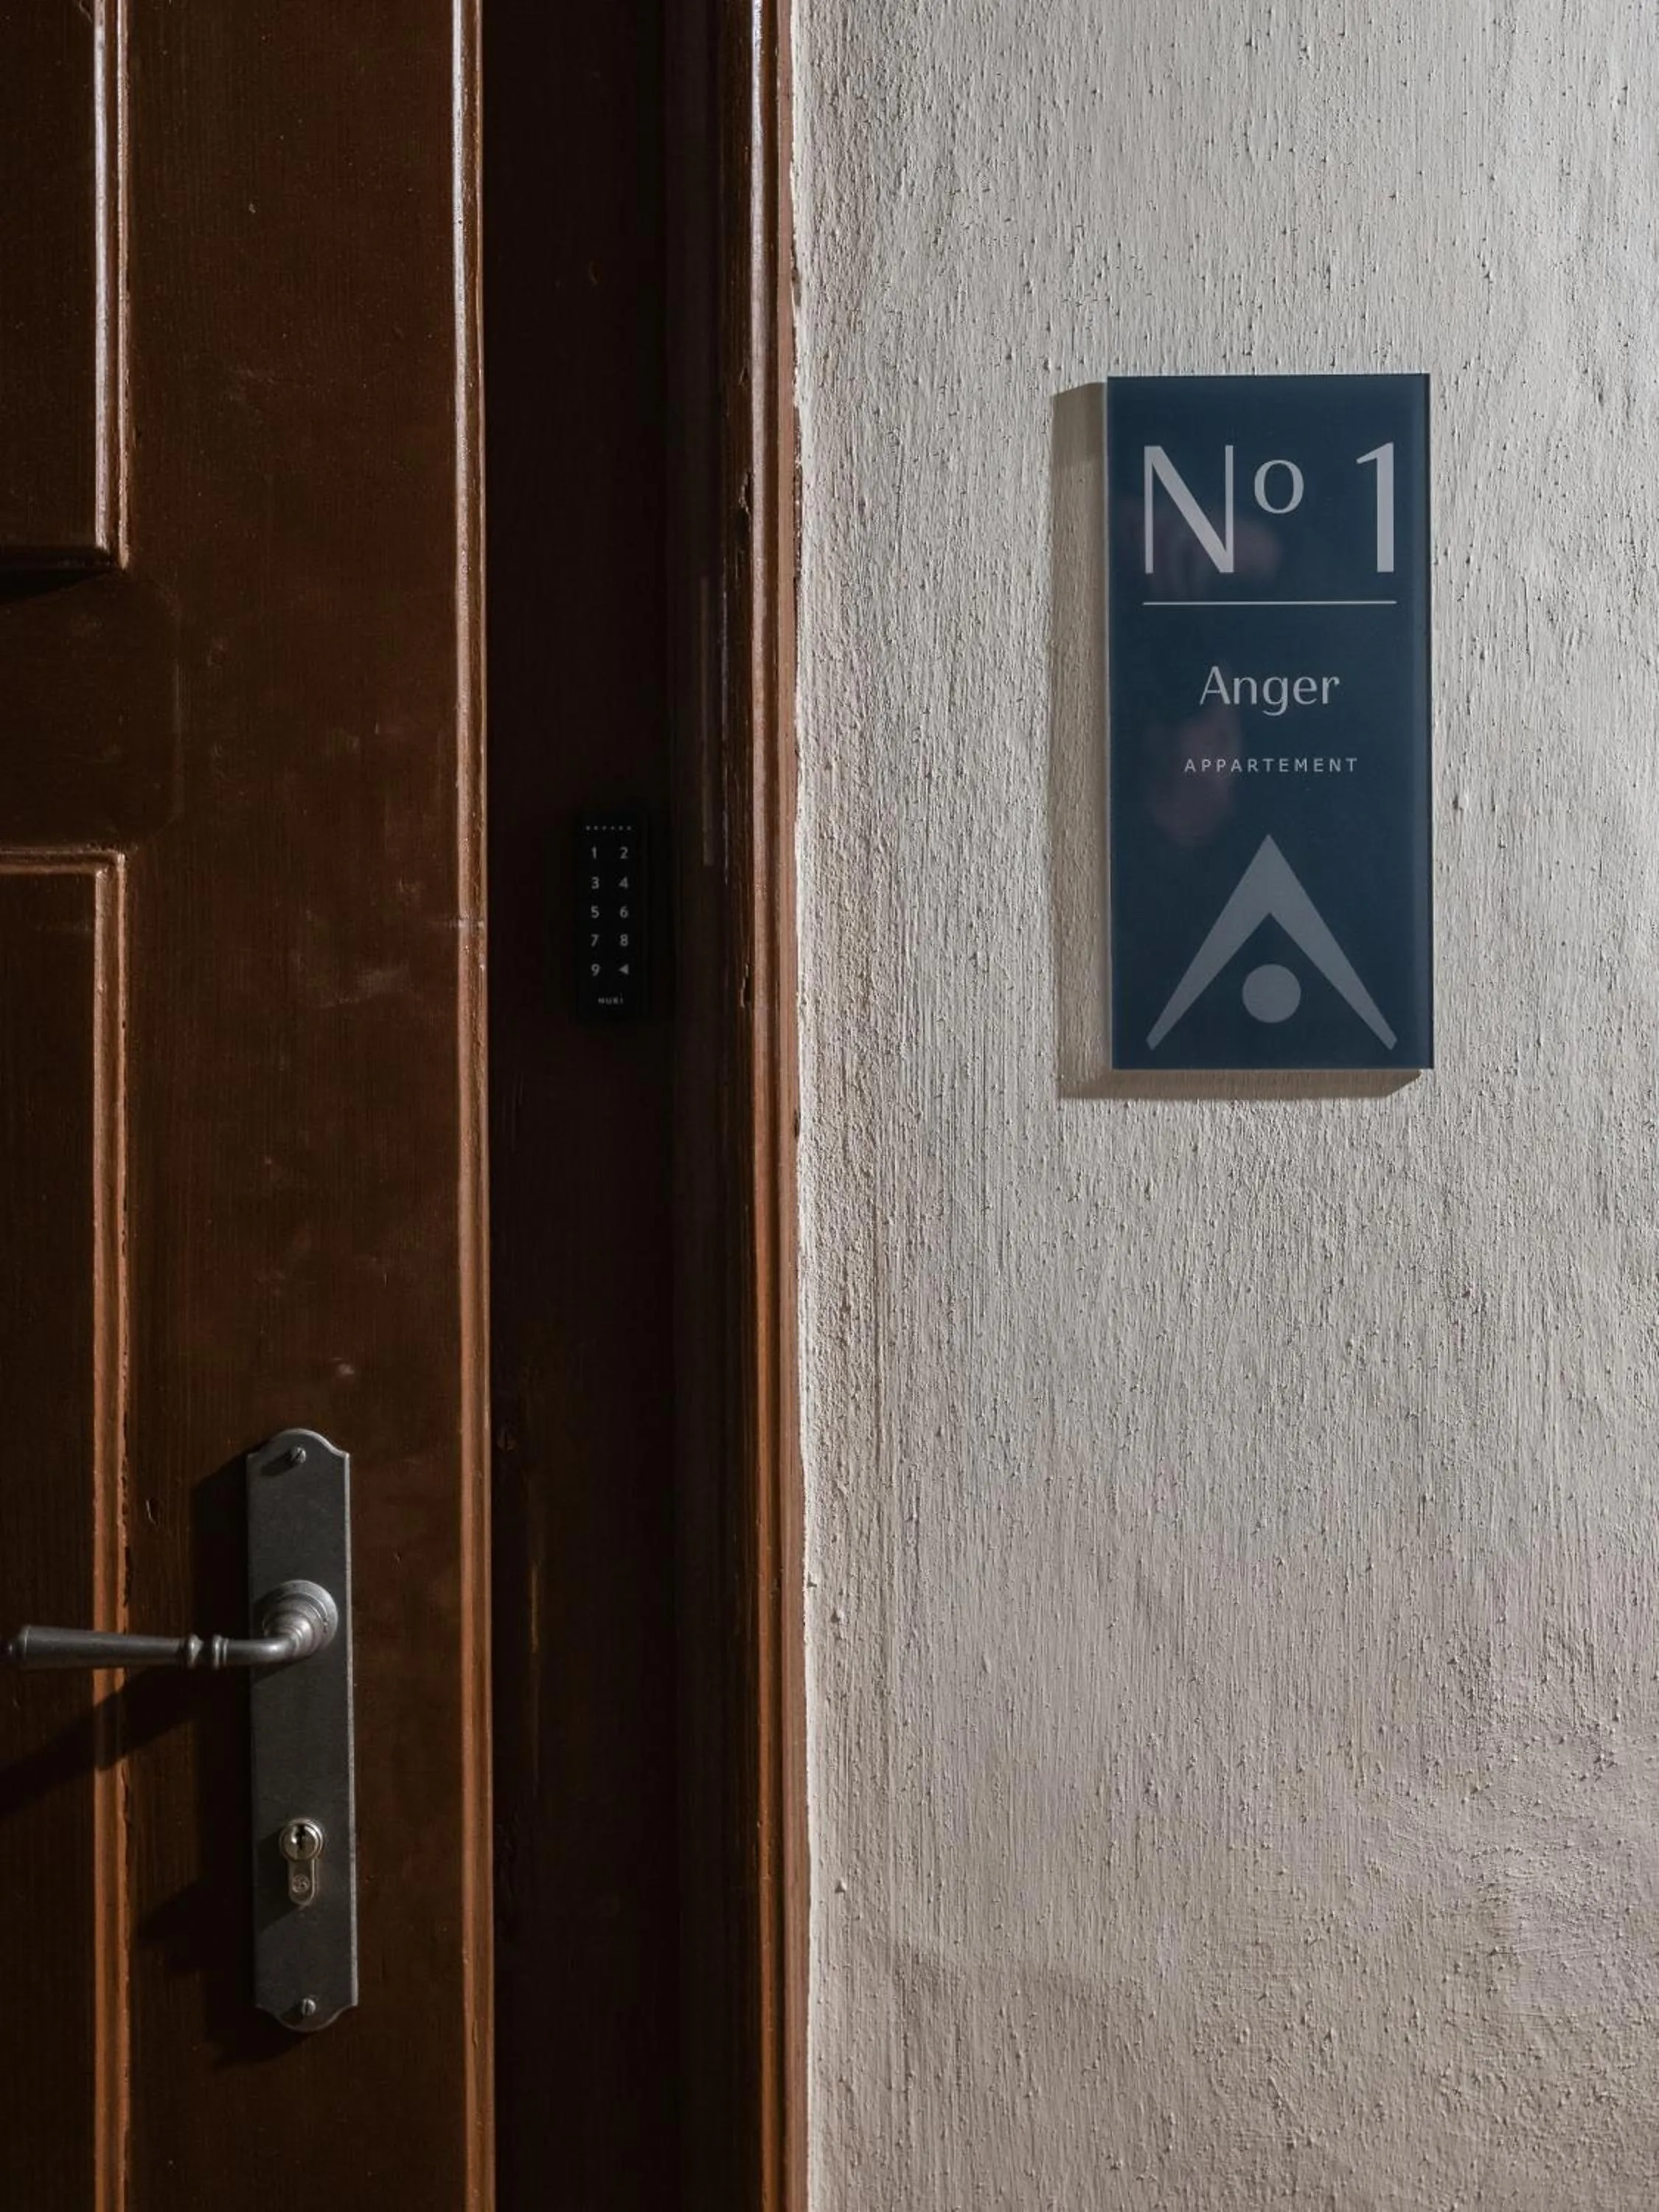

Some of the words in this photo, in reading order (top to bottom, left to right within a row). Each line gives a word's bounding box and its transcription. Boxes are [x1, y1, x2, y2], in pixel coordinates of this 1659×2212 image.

[1356, 442, 1394, 573] 1
[1200, 666, 1340, 716] Anger
[1184, 758, 1357, 773] APPARTEMENT
[619, 846, 629, 860] 2
[591, 876, 599, 889] 3
[619, 877, 629, 889] 4
[591, 905, 599, 919] 5
[619, 905, 629, 919] 6
[591, 933, 599, 947] 7
[619, 933, 629, 947] 8
[591, 963, 600, 976] 9
